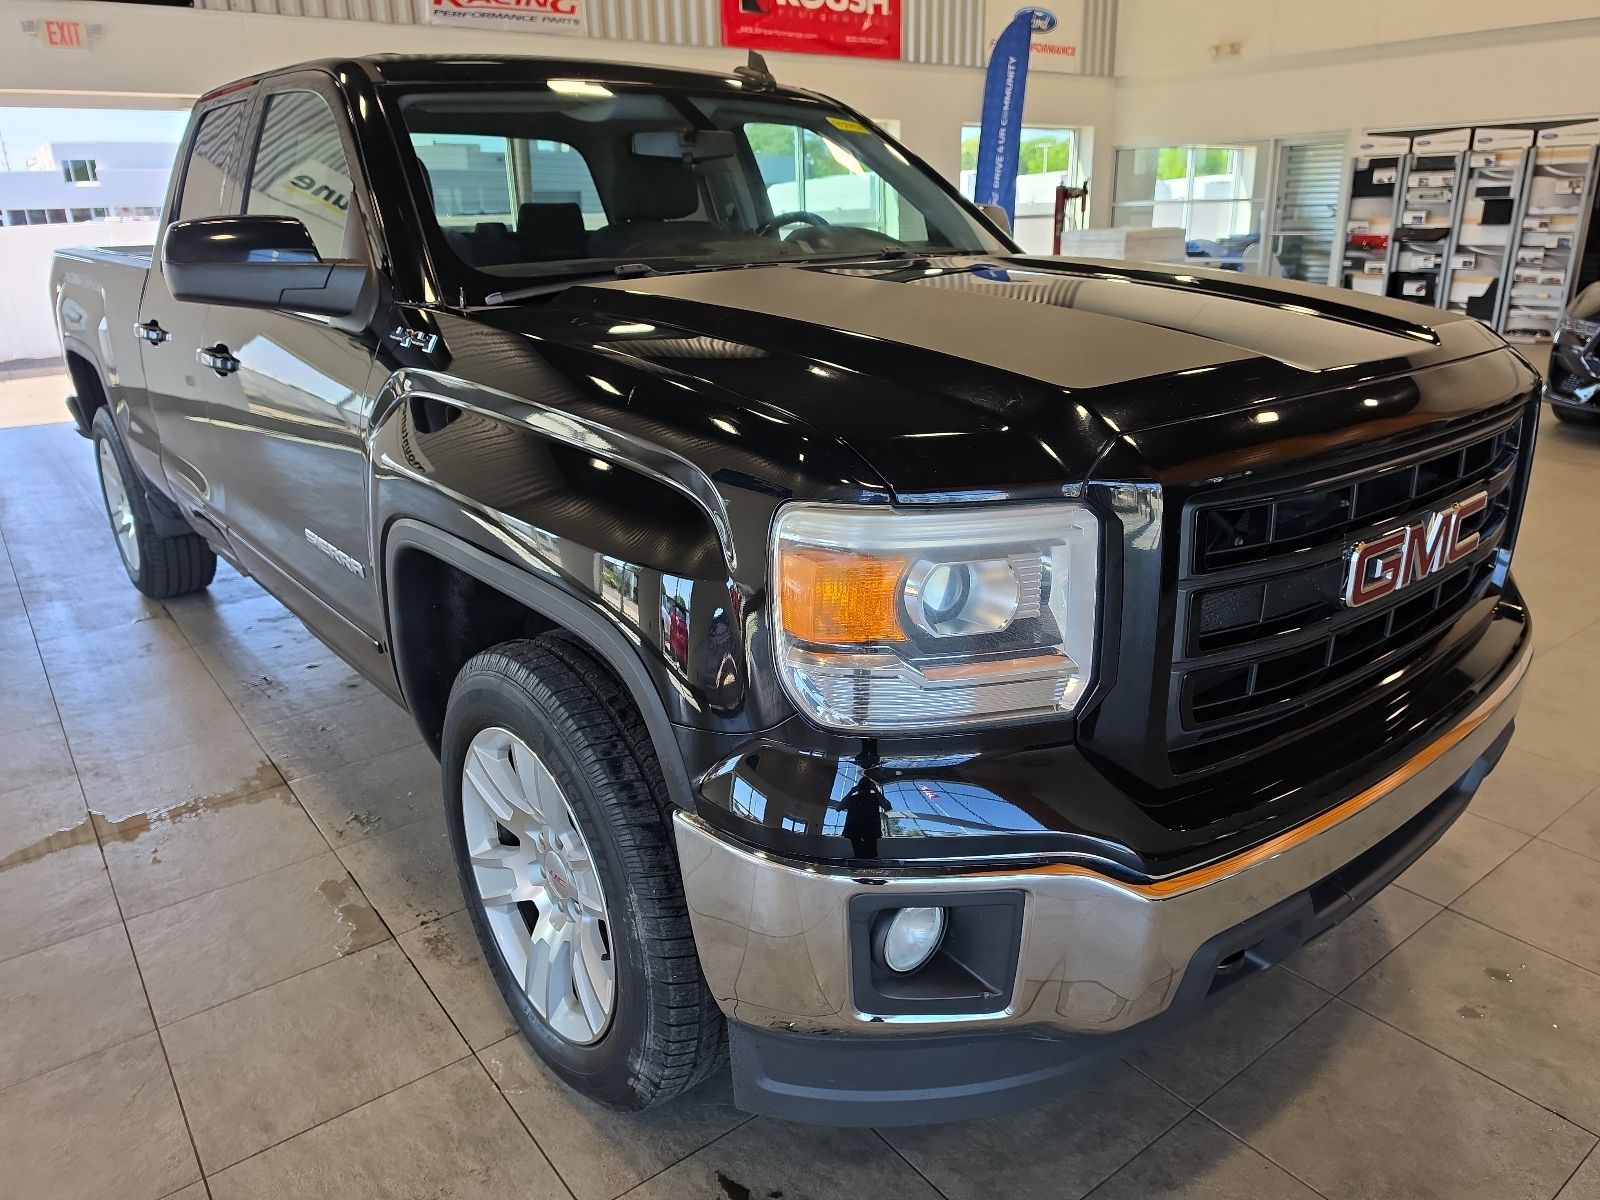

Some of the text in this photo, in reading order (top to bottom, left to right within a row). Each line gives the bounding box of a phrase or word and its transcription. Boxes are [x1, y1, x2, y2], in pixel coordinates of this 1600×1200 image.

[45, 20, 81, 46] EXIT
[433, 9, 580, 26] PERFORMANCE PARTS
[1030, 42, 1076, 57] FORMANCE
[993, 155, 1005, 188] DRIVE
[1000, 55, 1017, 126] COMMUNITY
[304, 528, 365, 579] SIERRA
[1345, 490, 1488, 608] GMC
